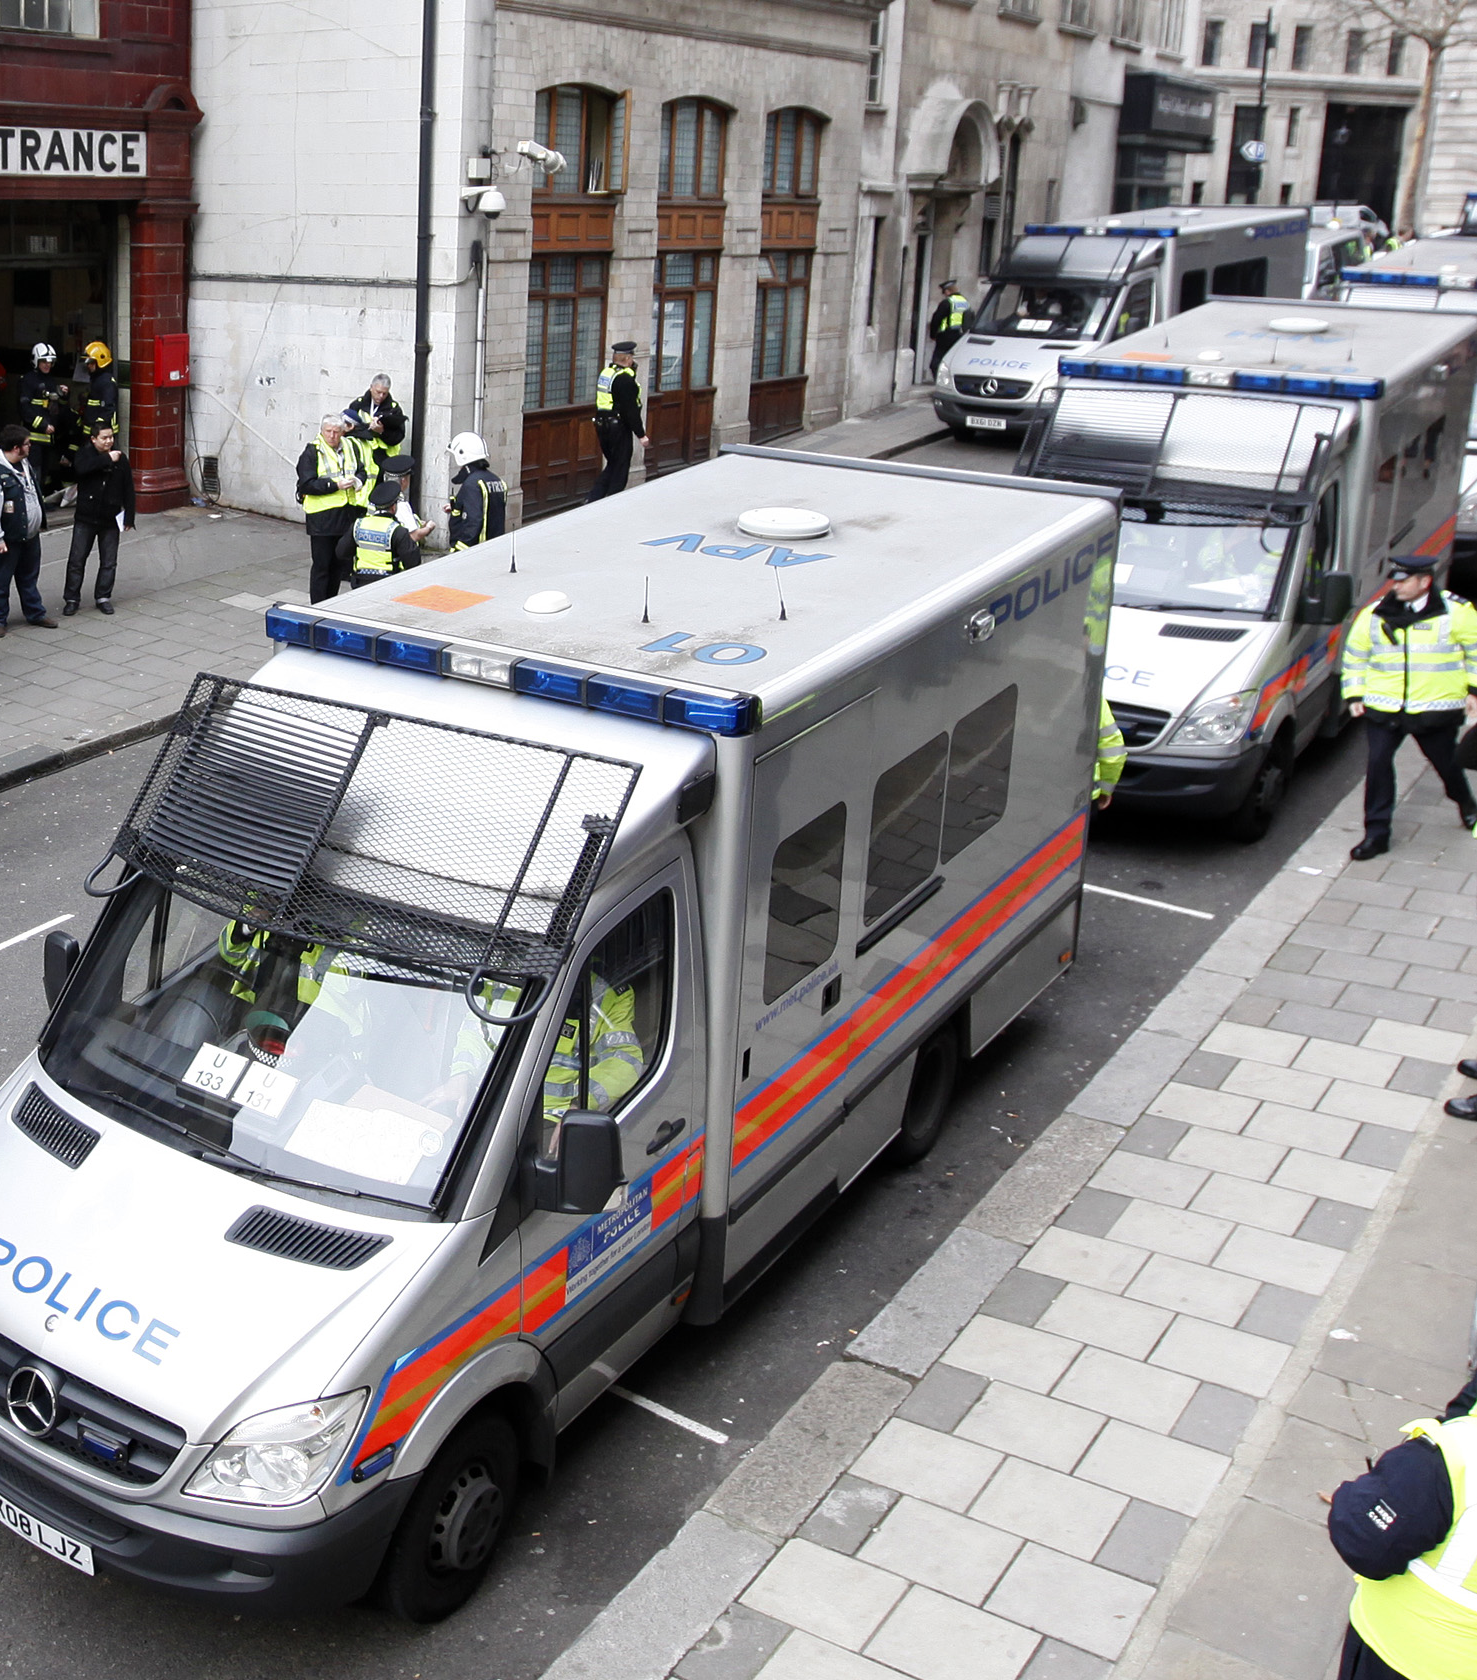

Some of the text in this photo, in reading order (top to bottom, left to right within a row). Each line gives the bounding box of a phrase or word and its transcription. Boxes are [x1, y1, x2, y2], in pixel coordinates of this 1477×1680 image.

[968, 358, 1032, 370] POLICE
[358, 532, 385, 543] POLICE
[638, 533, 836, 568] APV
[988, 531, 1114, 627] POLICE
[213, 1053, 227, 1068] U
[196, 1070, 223, 1090] 133
[263, 1073, 277, 1088] U
[246, 1090, 272, 1111] 131
[597, 1186, 649, 1235] METROPOLITAN
[603, 1206, 641, 1244] POLICE
[567, 1273, 587, 1295] Working
[37, 1523, 83, 1566] LJZ
